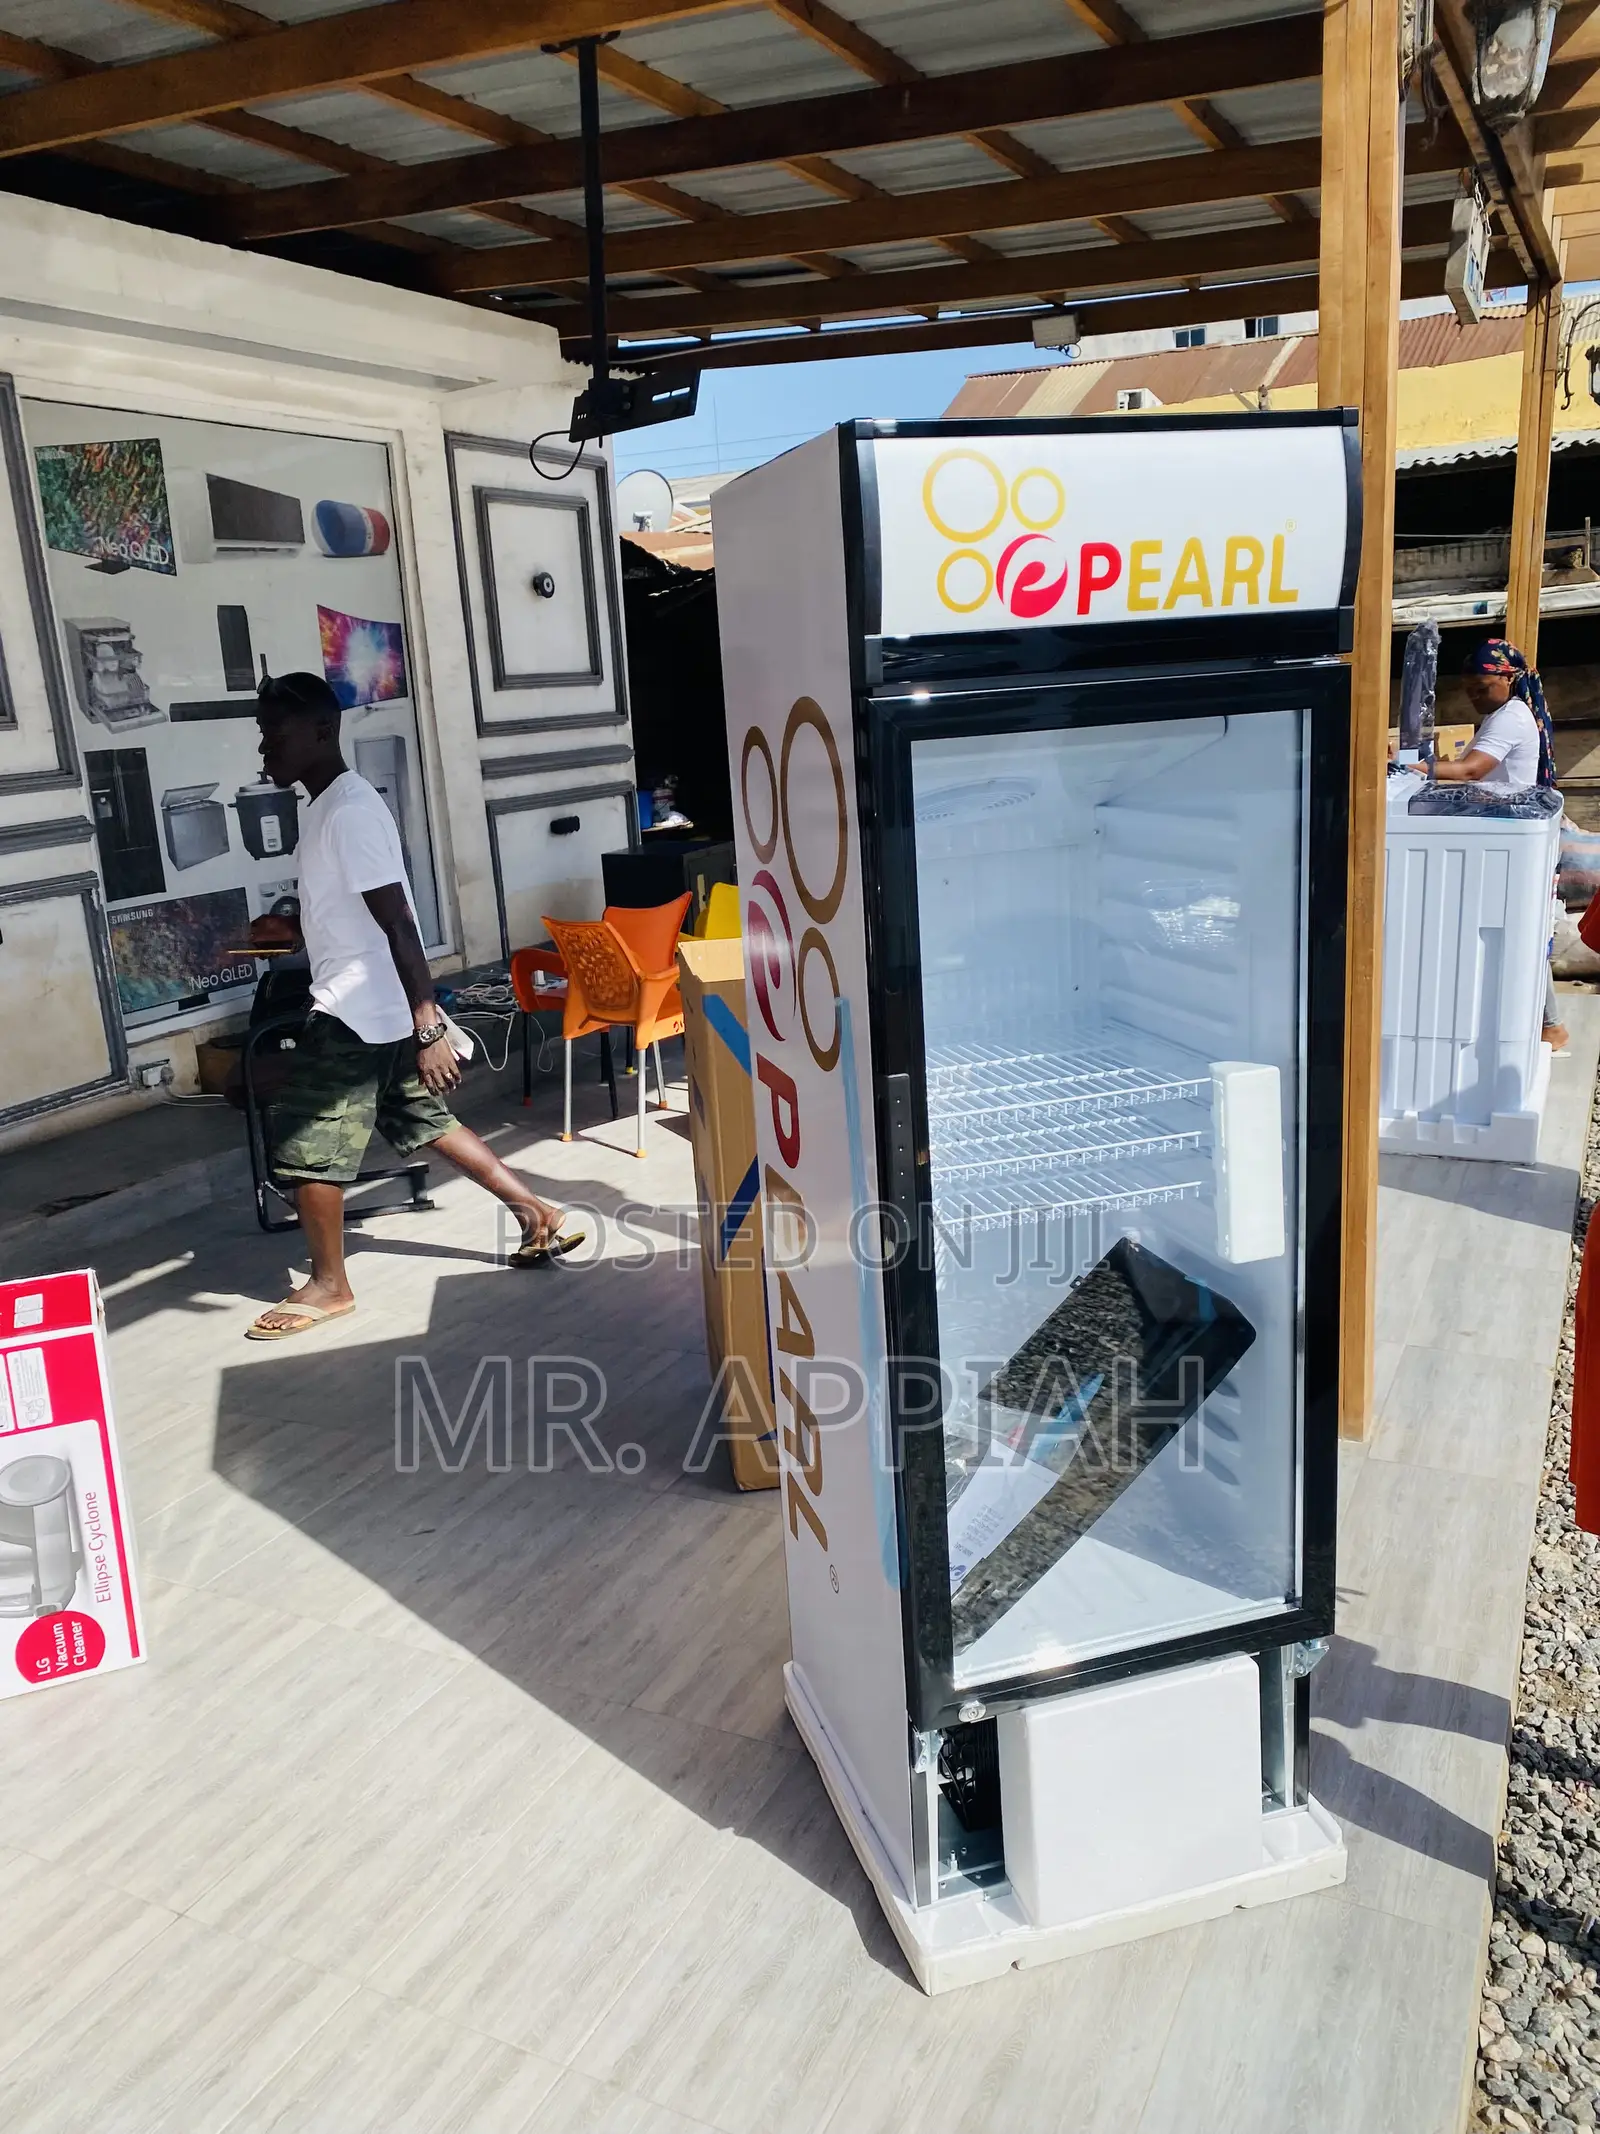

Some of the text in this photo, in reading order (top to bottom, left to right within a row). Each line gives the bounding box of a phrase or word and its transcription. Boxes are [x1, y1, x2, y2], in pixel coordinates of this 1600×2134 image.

[1076, 534, 1299, 615] PEARL
[110, 908, 154, 925] SAMSUNG
[188, 963, 253, 991] Neo QLED
[84, 1491, 112, 1604] Ellipse Cyclone
[36, 1656, 51, 1676] LG
[53, 1623, 69, 1671] Vacuum
[71, 1620, 87, 1667] Cleaner
